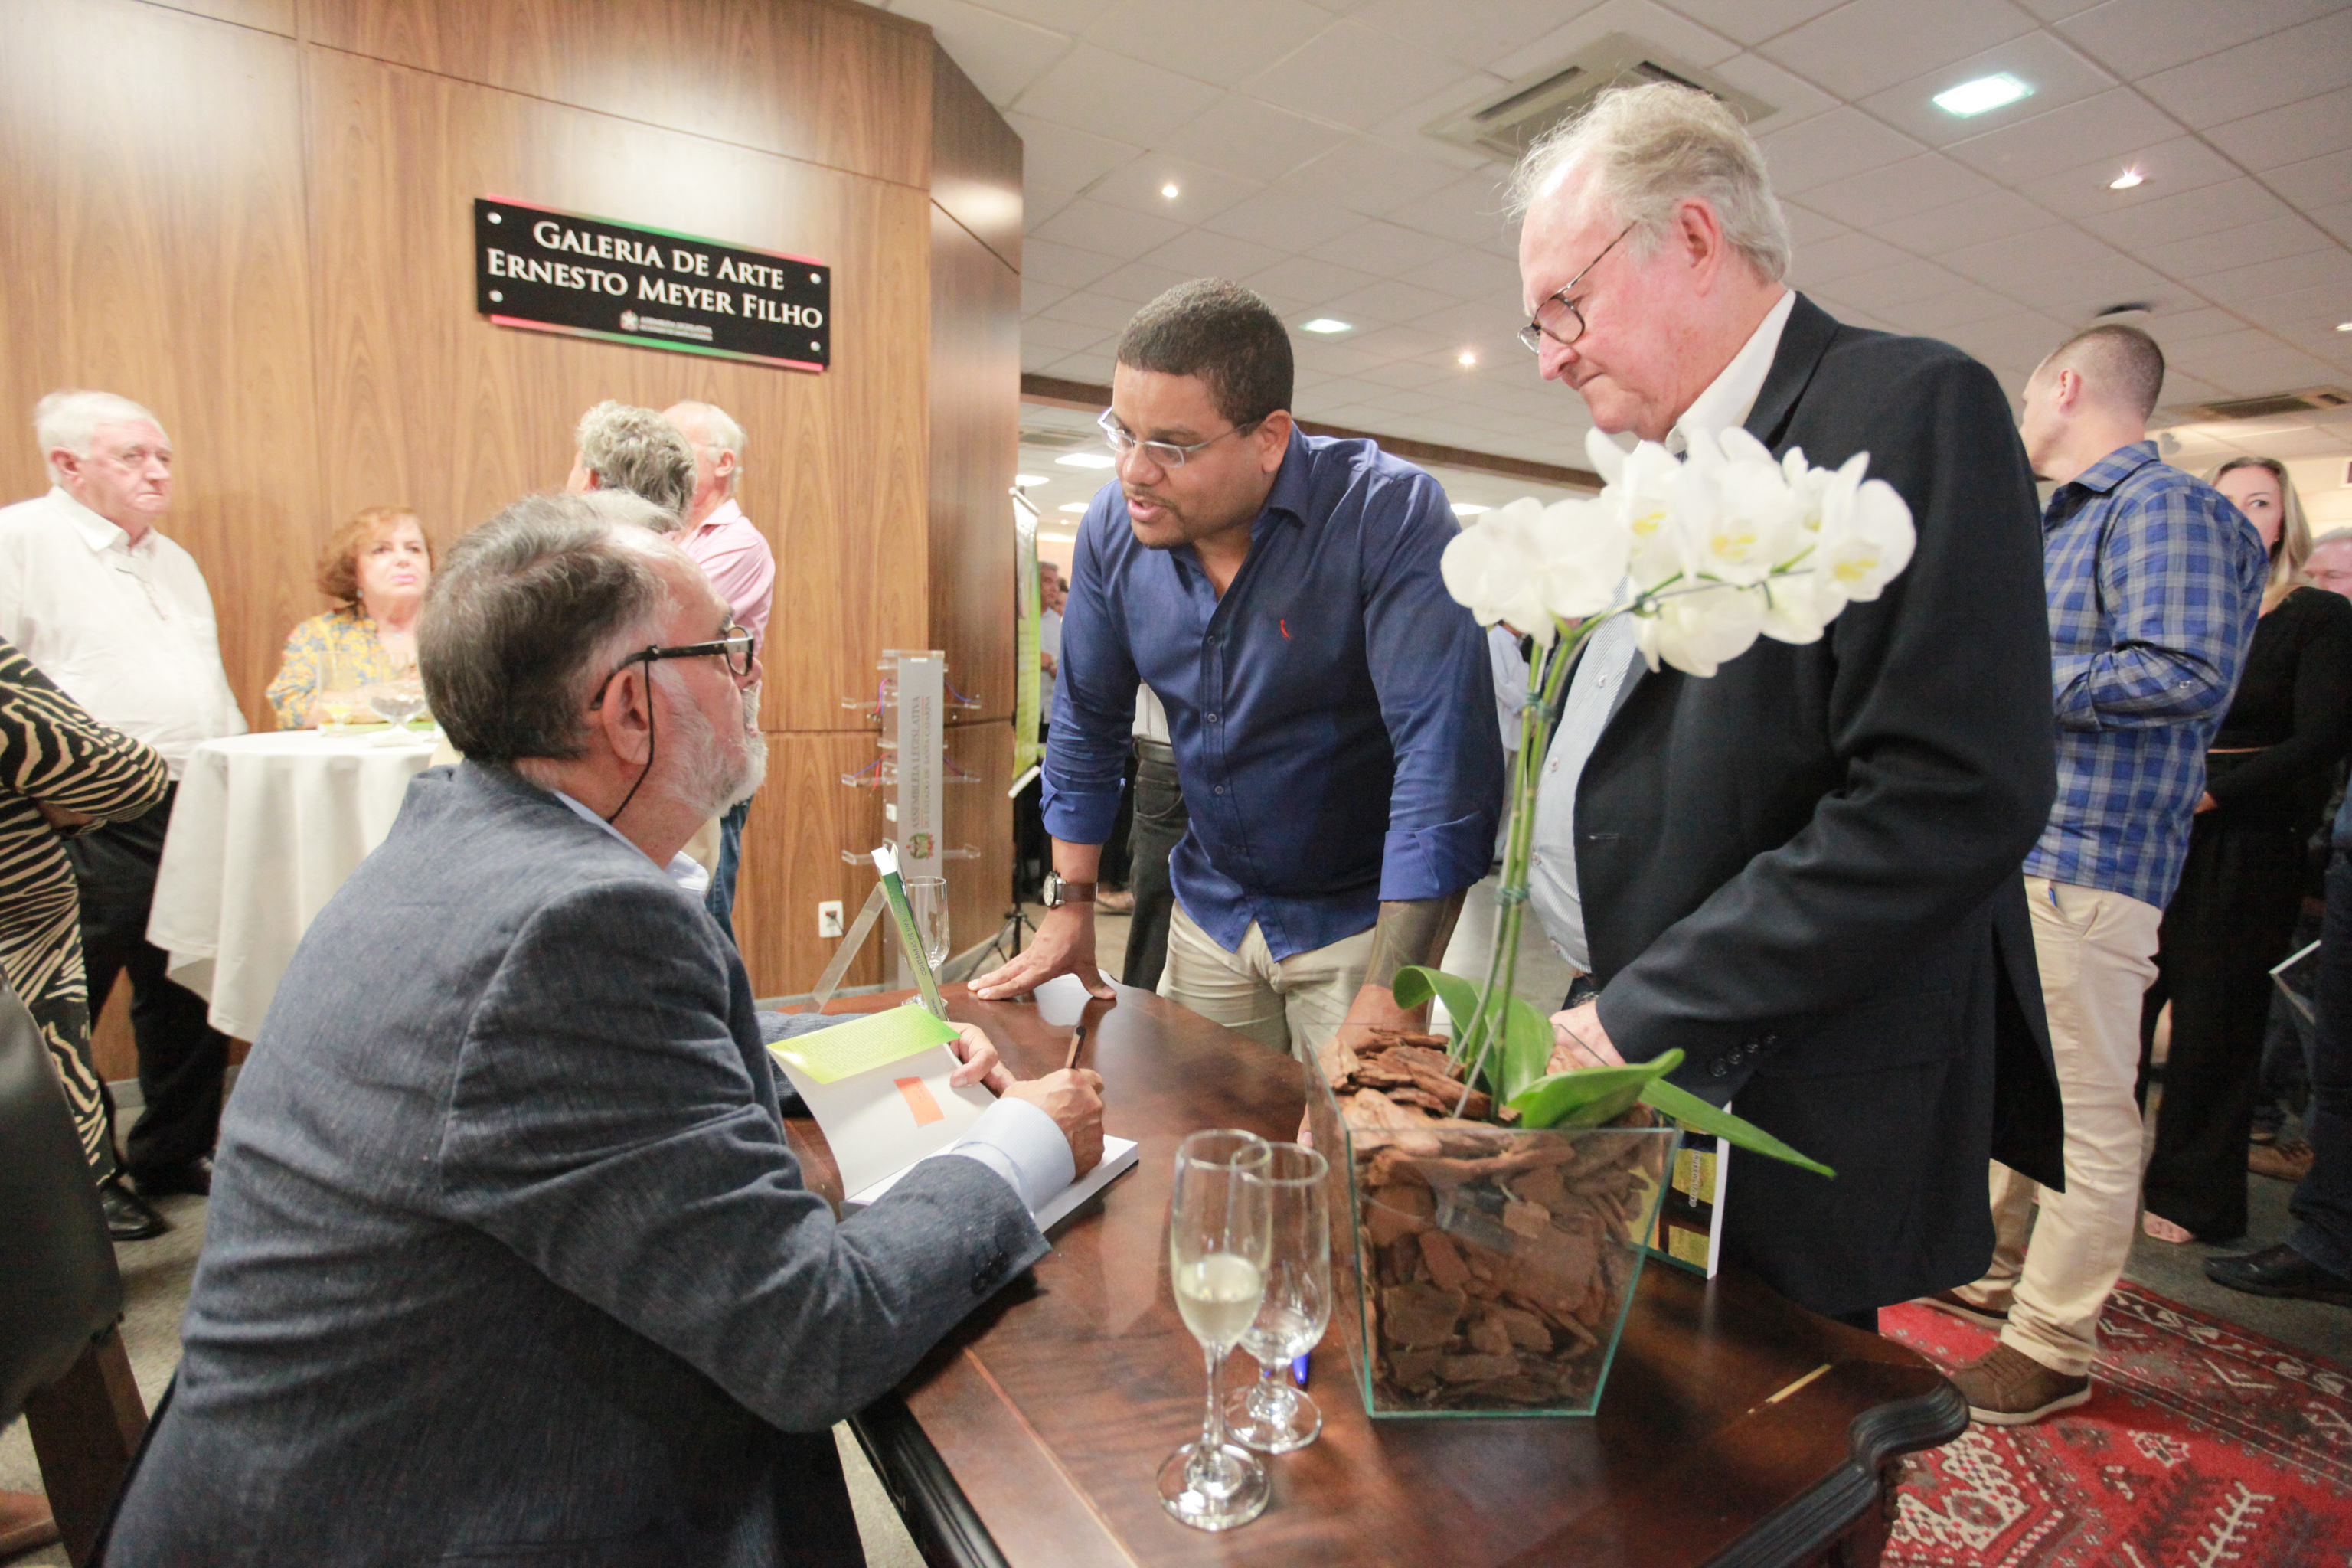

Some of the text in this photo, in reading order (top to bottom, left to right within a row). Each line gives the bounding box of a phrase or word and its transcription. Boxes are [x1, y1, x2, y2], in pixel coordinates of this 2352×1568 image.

[487, 247, 628, 296] ERNESTO
[638, 275, 735, 315] MEYER
[743, 292, 823, 328] FILHO
[533, 220, 785, 291] GALERIA DE ARTE
[911, 696, 920, 829] ASSEMBLEIA LEGISLATIVA
